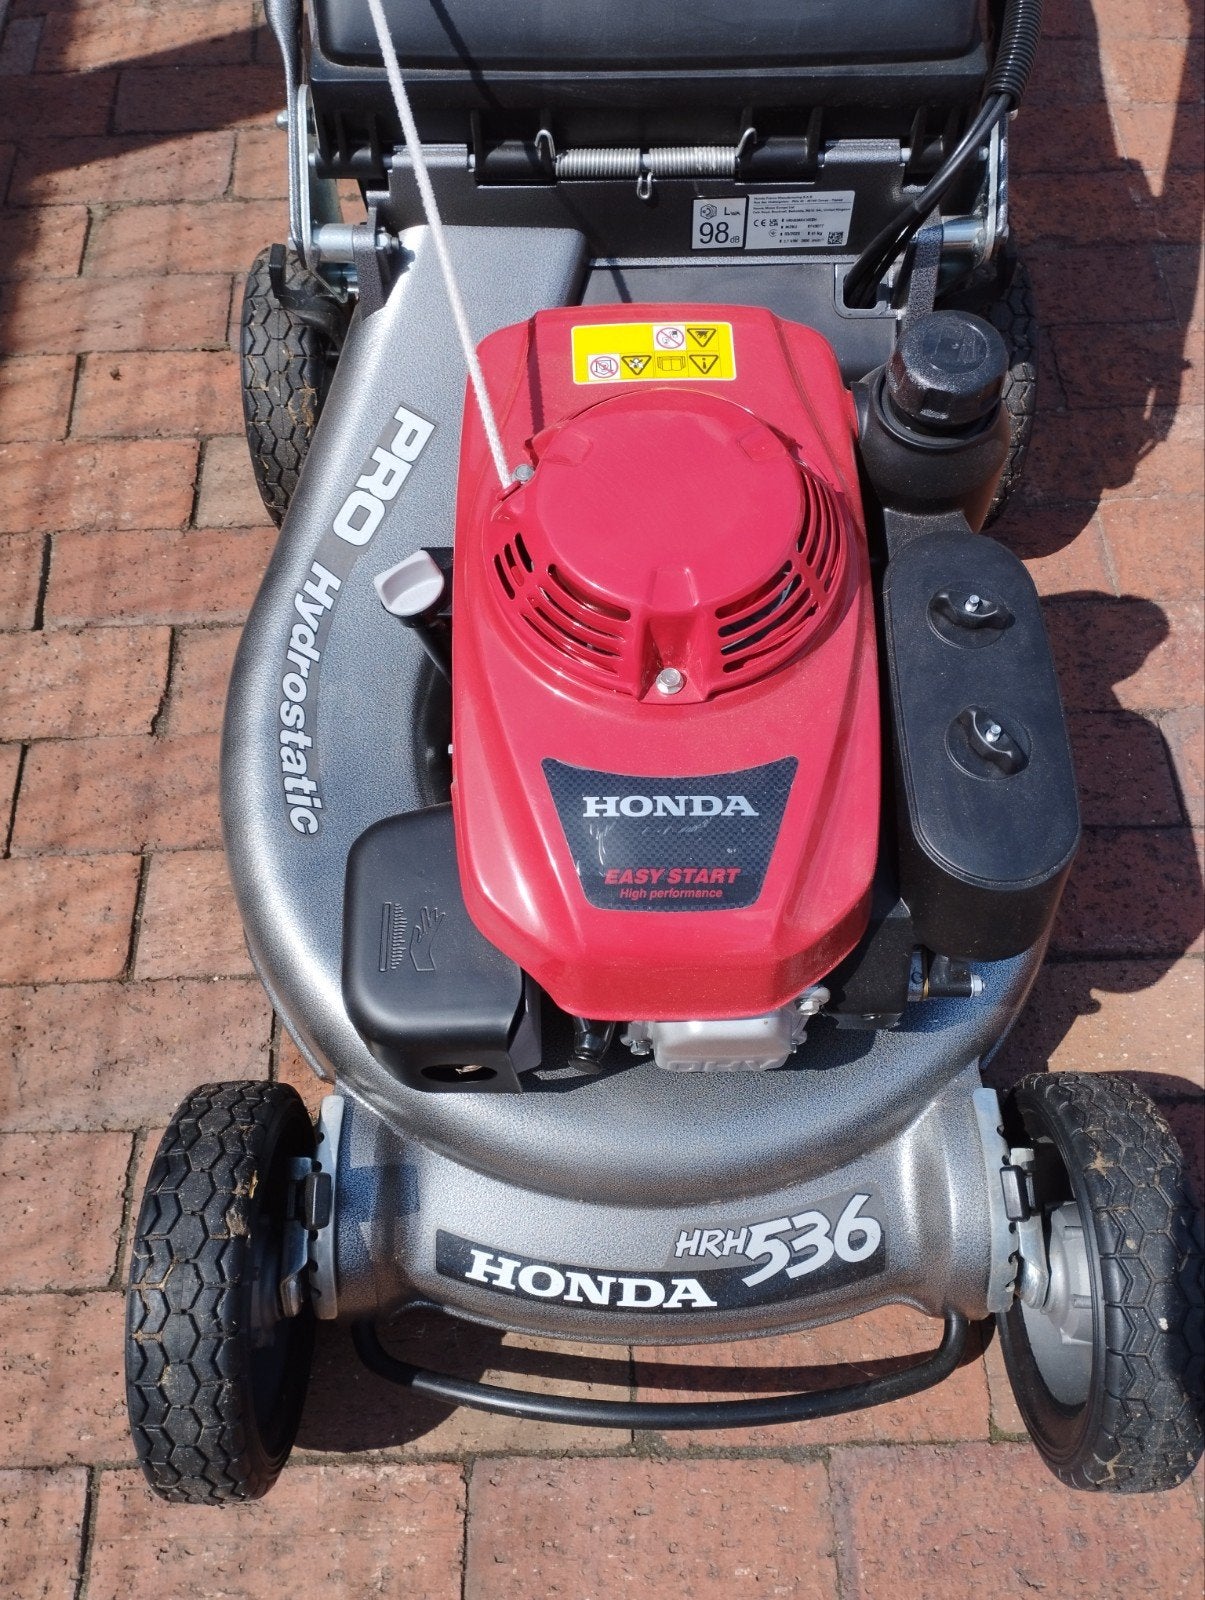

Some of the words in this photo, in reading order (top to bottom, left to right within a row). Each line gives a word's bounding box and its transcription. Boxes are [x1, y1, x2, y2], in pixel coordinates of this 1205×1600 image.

[699, 221, 729, 244] 98
[729, 235, 740, 243] dB
[332, 405, 437, 547] PRO
[278, 560, 343, 836] Hydrostatic
[582, 795, 760, 818] HONDA
[604, 867, 665, 885] EASY
[667, 867, 741, 885] START
[619, 888, 647, 900] High
[649, 888, 723, 900] performance
[464, 1248, 718, 1309] HONDA
